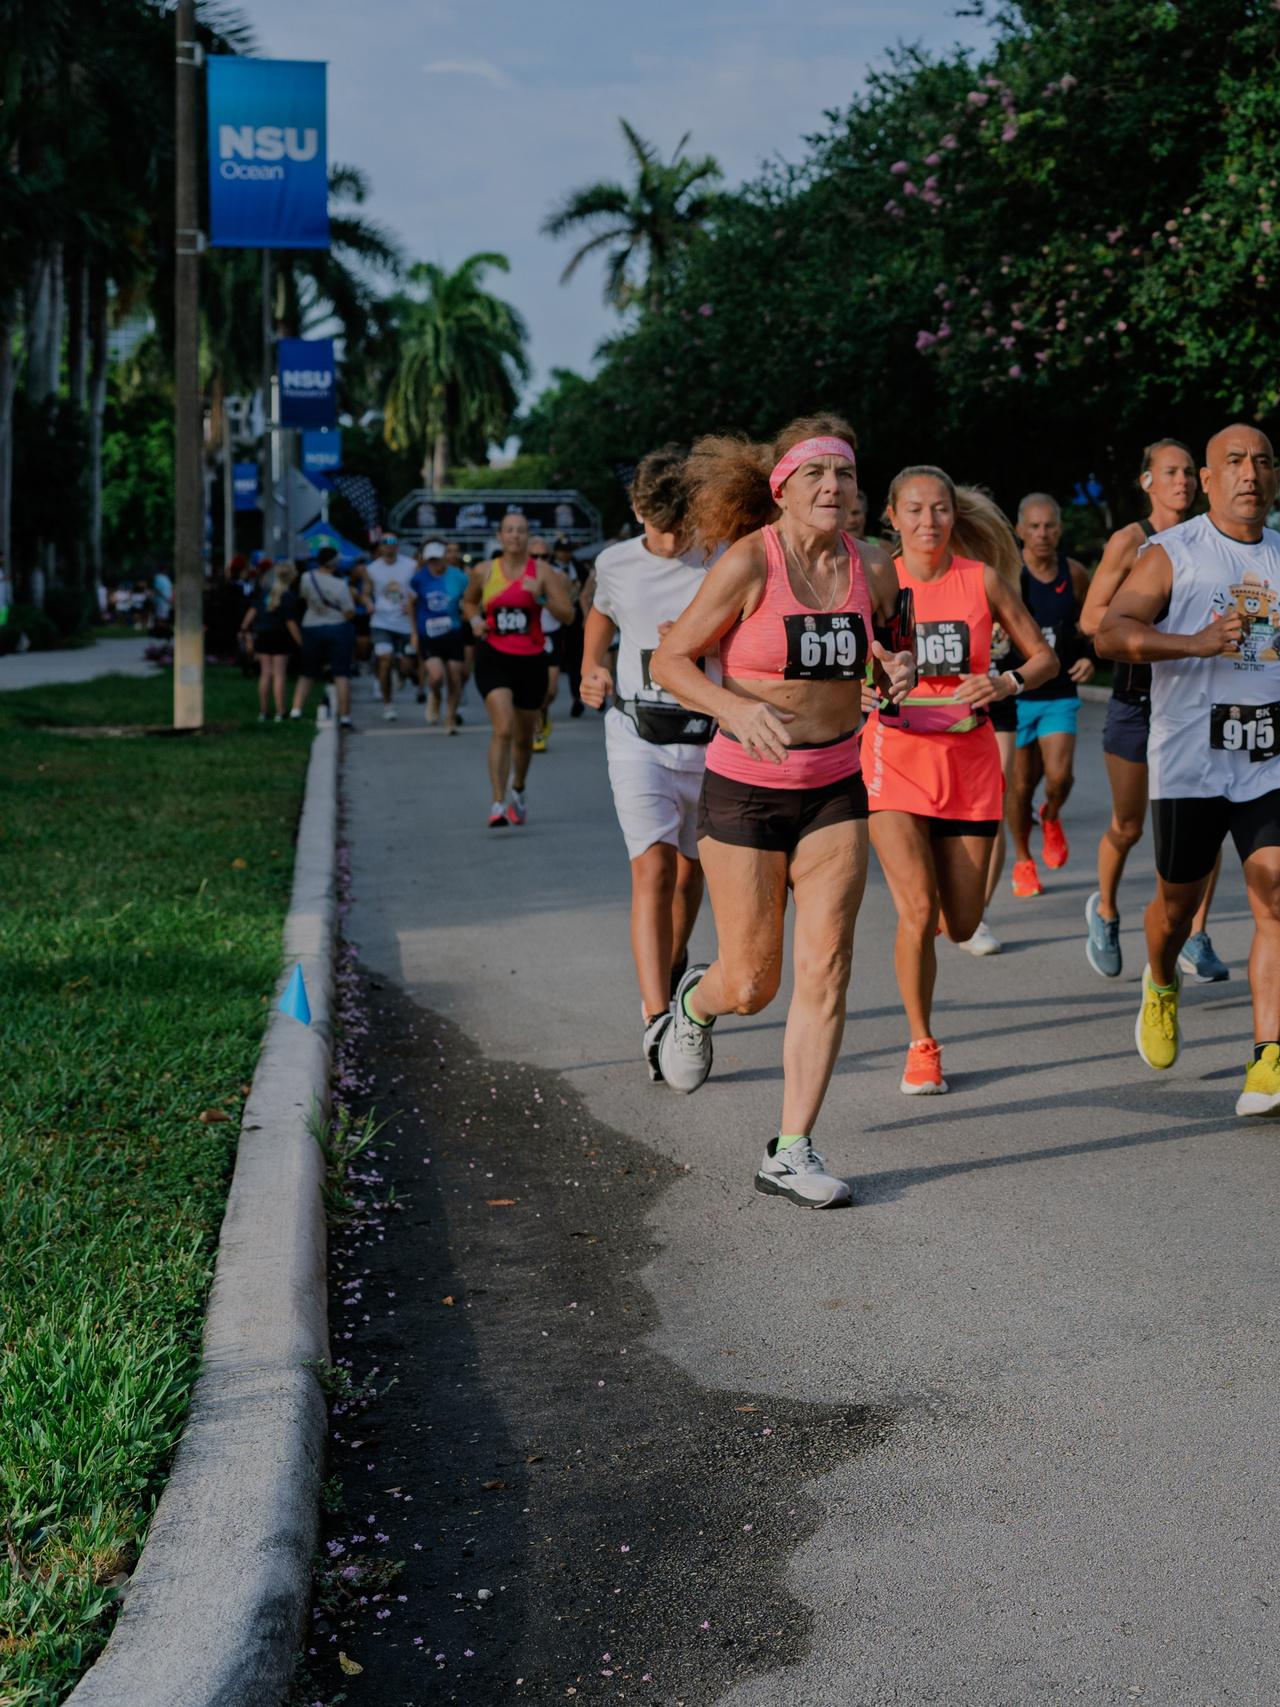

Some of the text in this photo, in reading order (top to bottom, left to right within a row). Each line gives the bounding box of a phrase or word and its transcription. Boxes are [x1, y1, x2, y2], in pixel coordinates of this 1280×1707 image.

[219, 124, 318, 162] NSU
[220, 160, 284, 180] Ocean
[282, 370, 332, 389] NSU
[497, 612, 528, 631] 520
[831, 617, 851, 629] 5K
[938, 623, 956, 634] 5K
[800, 630, 857, 667] 619
[1244, 650, 1257, 662] 5K
[1233, 662, 1265, 672] TACO TROT
[1255, 708, 1271, 719] 5K
[1222, 718, 1275, 751] 915
